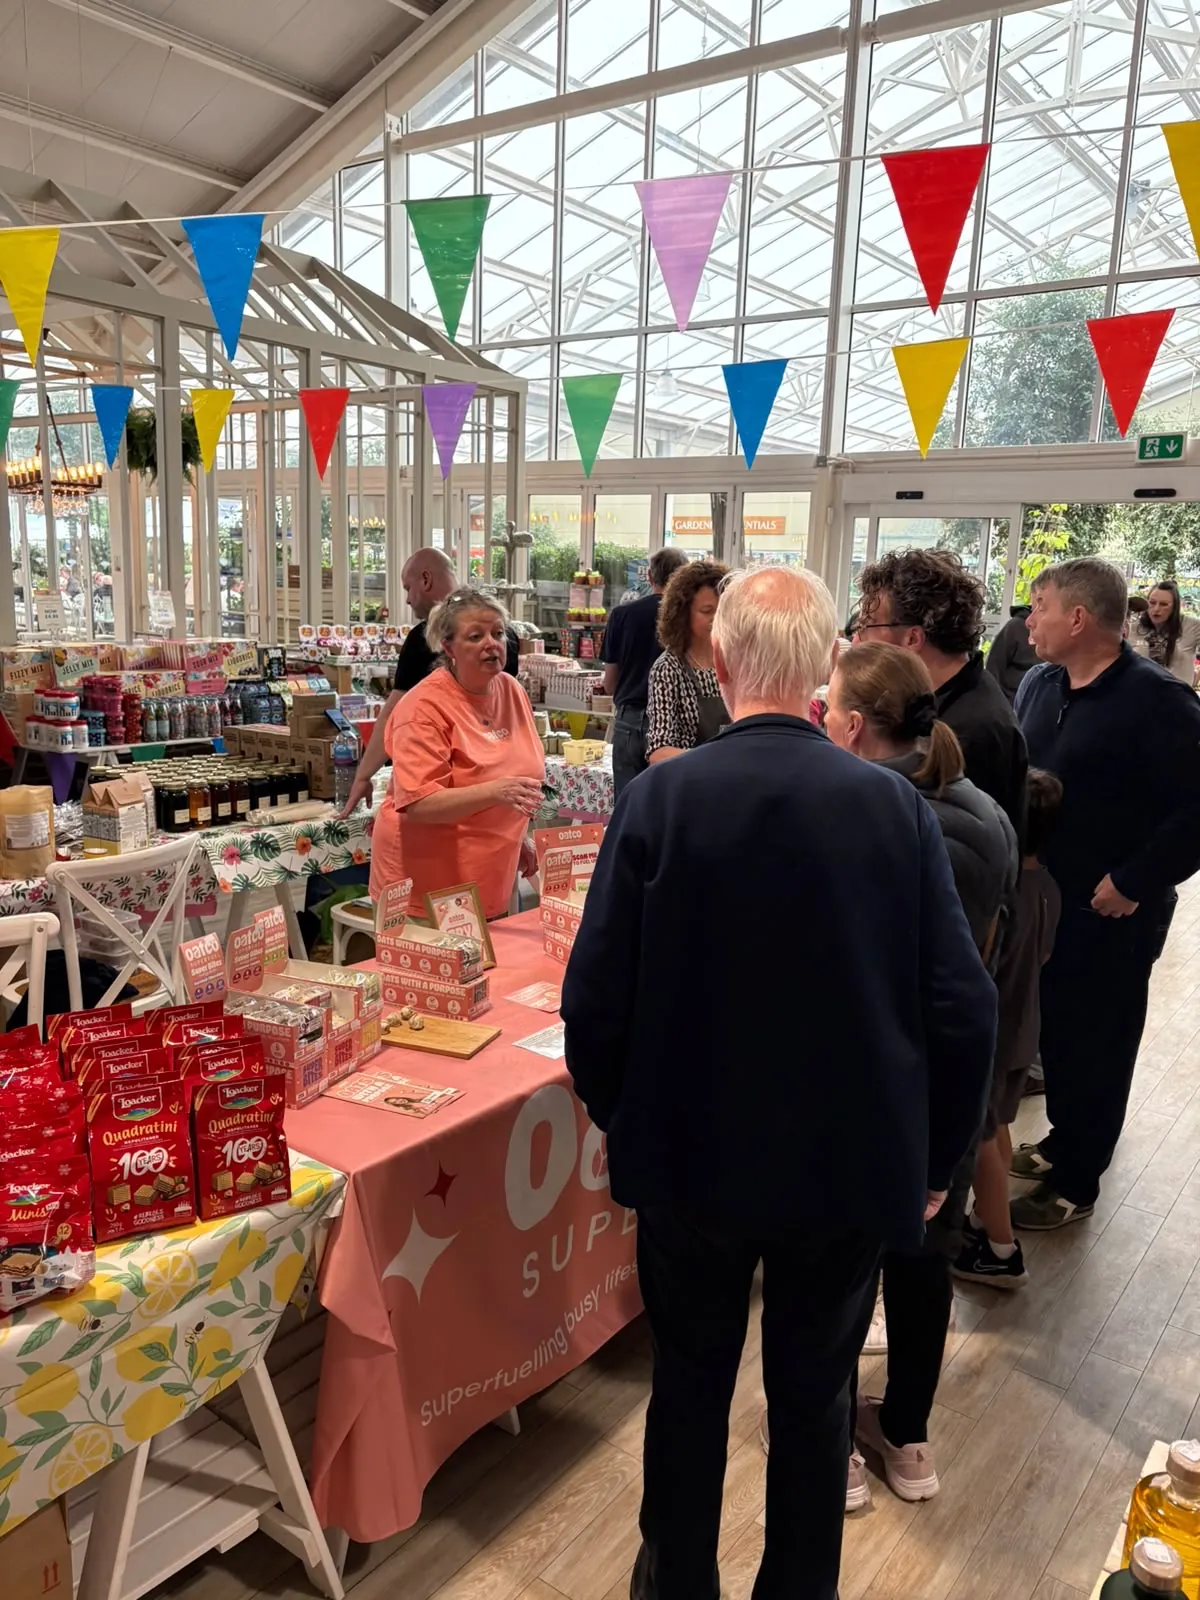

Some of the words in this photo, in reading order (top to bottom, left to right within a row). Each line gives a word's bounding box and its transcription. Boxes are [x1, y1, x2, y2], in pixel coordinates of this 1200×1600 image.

[62, 664, 80, 676] JELLY
[82, 658, 94, 669] MIX
[99, 656, 111, 666] MIX
[10, 668, 29, 680] FIZZY
[31, 664, 44, 674] MIX
[558, 830, 582, 841] oatco
[546, 853, 572, 867] oatco
[387, 885, 411, 900] oatco
[234, 927, 264, 949] oatco
[185, 938, 219, 961] oatco
[395, 938, 415, 951] WITH
[415, 943, 421, 951] A
[421, 944, 458, 958] PURPOSE
[404, 977, 421, 988] WITH
[422, 980, 429, 989] A
[429, 981, 466, 996] PURPOSE
[73, 1014, 108, 1027] Loacker
[168, 1012, 200, 1022] Loacker
[87, 1029, 122, 1042] Loacker
[187, 1027, 219, 1037] Loacker
[247, 1021, 292, 1037] PURPOSE
[98, 1046, 135, 1059] Loacker
[334, 1038, 353, 1055] SUPER
[204, 1056, 239, 1071] Loacker
[334, 1051, 353, 1067] BITES
[106, 1060, 144, 1074] Loacker
[222, 1085, 259, 1098] Loacker
[117, 1094, 157, 1109] Loacker
[208, 1111, 275, 1134] Quadratini
[102, 1120, 178, 1146] Quadratini
[221, 1136, 268, 1167] 100
[238, 1141, 262, 1155] YEARS
[117, 1147, 169, 1181] 100
[137, 1153, 163, 1167] YEARS
[5, 1182, 51, 1195] Loacker
[6, 1205, 49, 1222] Minis
[420, 1325, 569, 1427] superfuelling
[564, 1284, 601, 1335] busy
